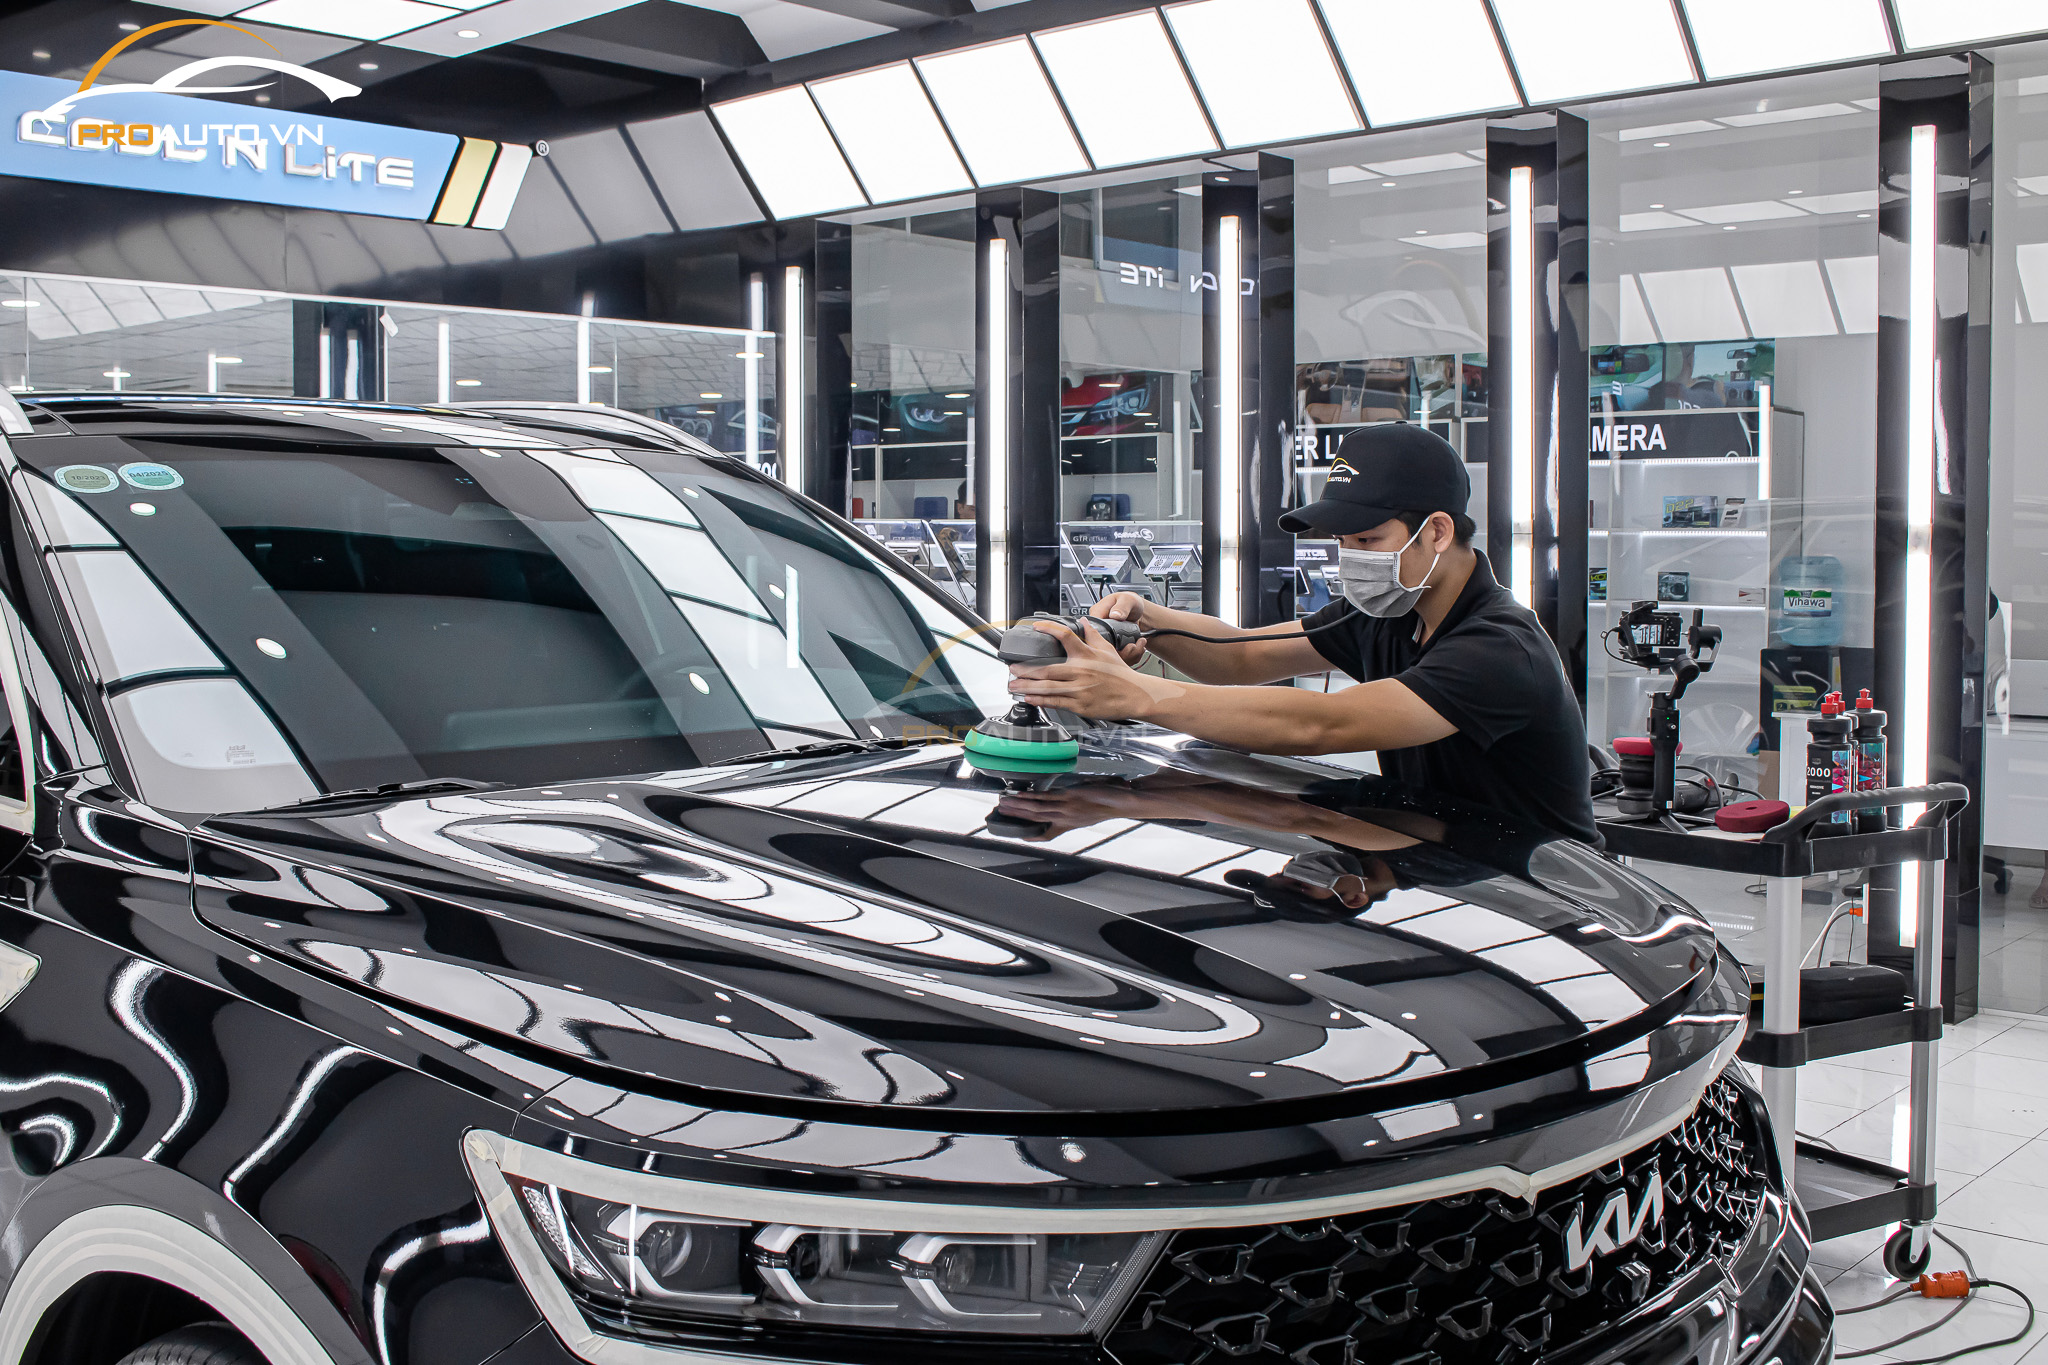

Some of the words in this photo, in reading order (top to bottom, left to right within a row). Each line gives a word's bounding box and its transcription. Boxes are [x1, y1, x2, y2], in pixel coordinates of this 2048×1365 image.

[1590, 423, 1667, 452] MERA
[1788, 596, 1825, 608] Vihawa
[1806, 766, 1831, 778] 2000
